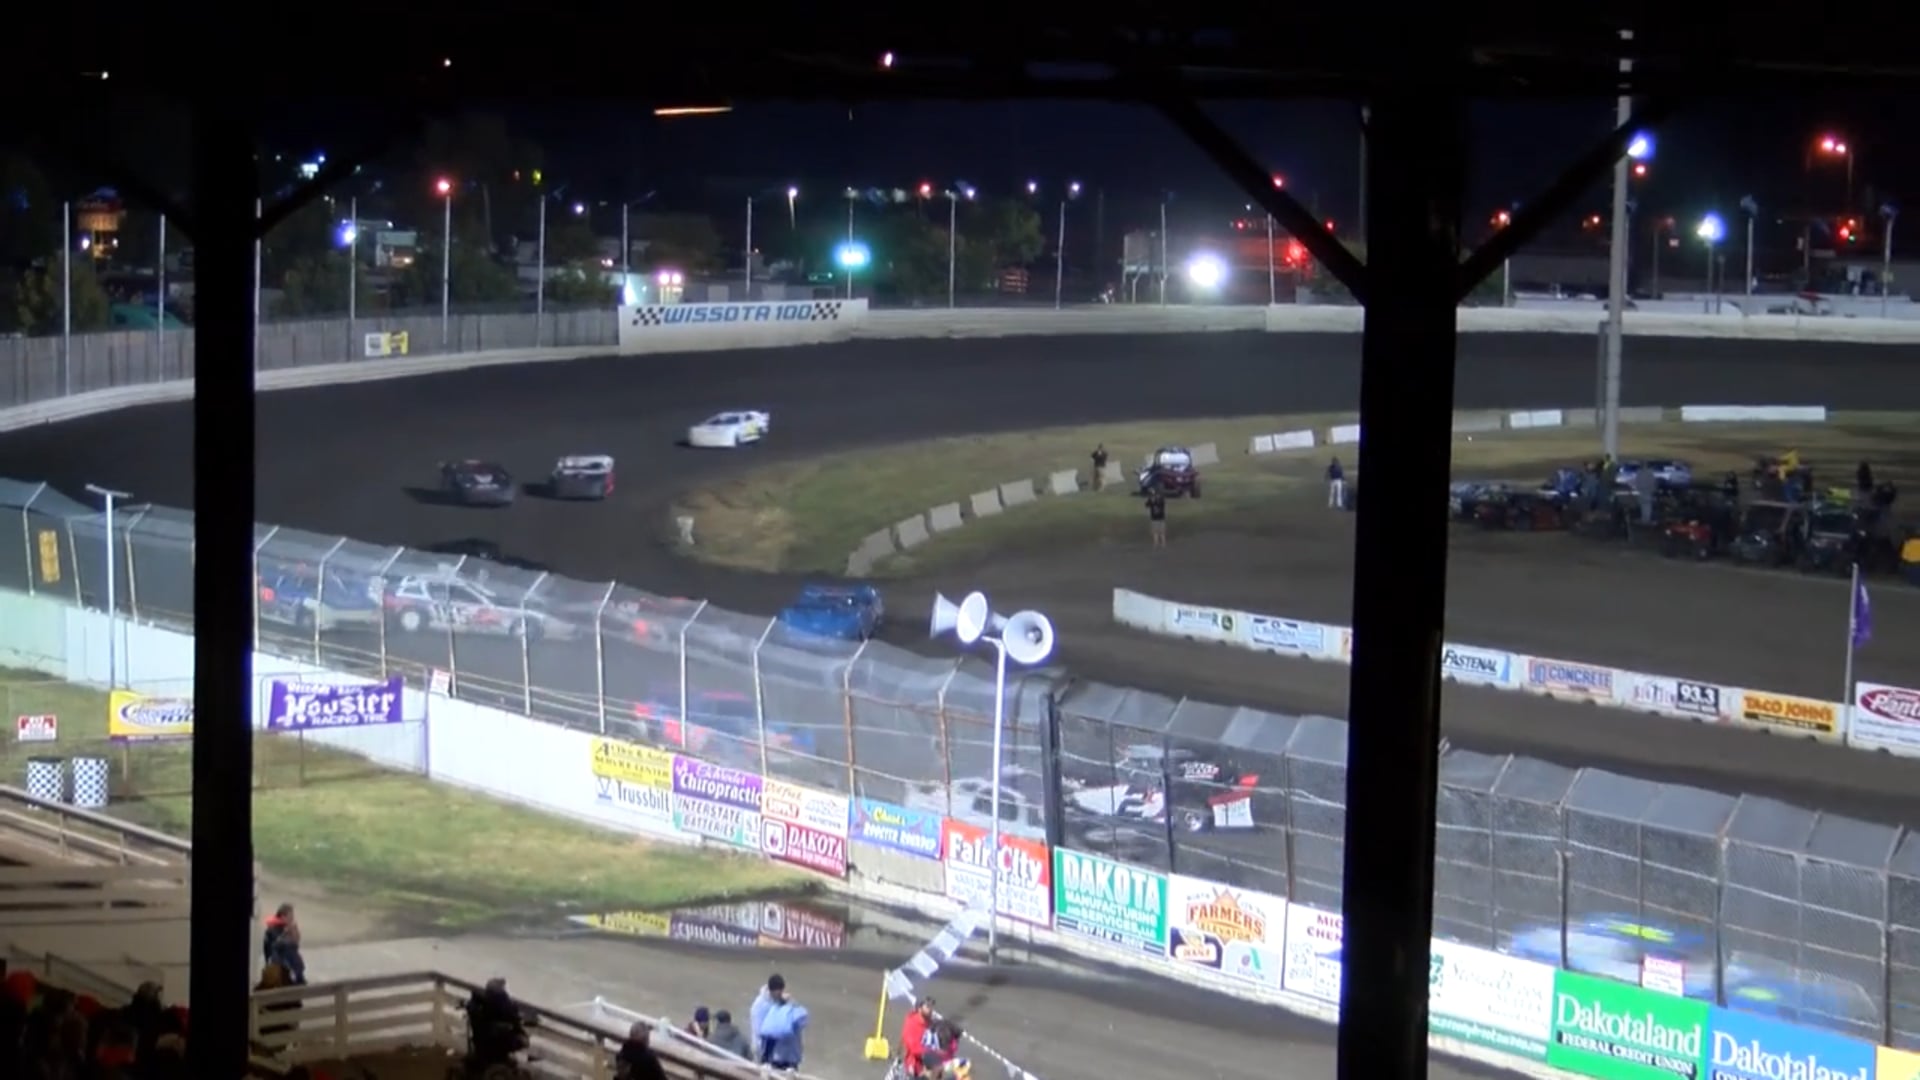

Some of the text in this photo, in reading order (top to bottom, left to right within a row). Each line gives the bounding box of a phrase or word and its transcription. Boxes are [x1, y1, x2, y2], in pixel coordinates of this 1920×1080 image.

[663, 303, 813, 325] WISSOTA 100
[1444, 650, 1497, 674] FASTENAL
[1550, 663, 1611, 688] CONCRETE
[1680, 684, 1716, 704] 93.3
[1744, 696, 1783, 714] TACO
[311, 713, 388, 726] RACING TIRE
[616, 779, 670, 813] Trussbilt
[680, 771, 762, 806] Chiropractic
[677, 797, 742, 824] INTERSTATE
[682, 813, 736, 838] BATTERIES
[788, 826, 844, 861] DAKOTA
[949, 831, 992, 869] Fair
[998, 844, 1042, 888] City
[1063, 853, 1161, 916] DAKOTA
[1065, 889, 1157, 926] MANUFACTURING
[1189, 904, 1263, 937] FARMERS
[1557, 992, 1702, 1058] Dakotaland
[1562, 1032, 1611, 1055] FEDERAL
[1612, 1043, 1654, 1065] CREDIT
[1655, 1055, 1694, 1075] UNION
[1712, 1030, 1868, 1080] Dakotaland
